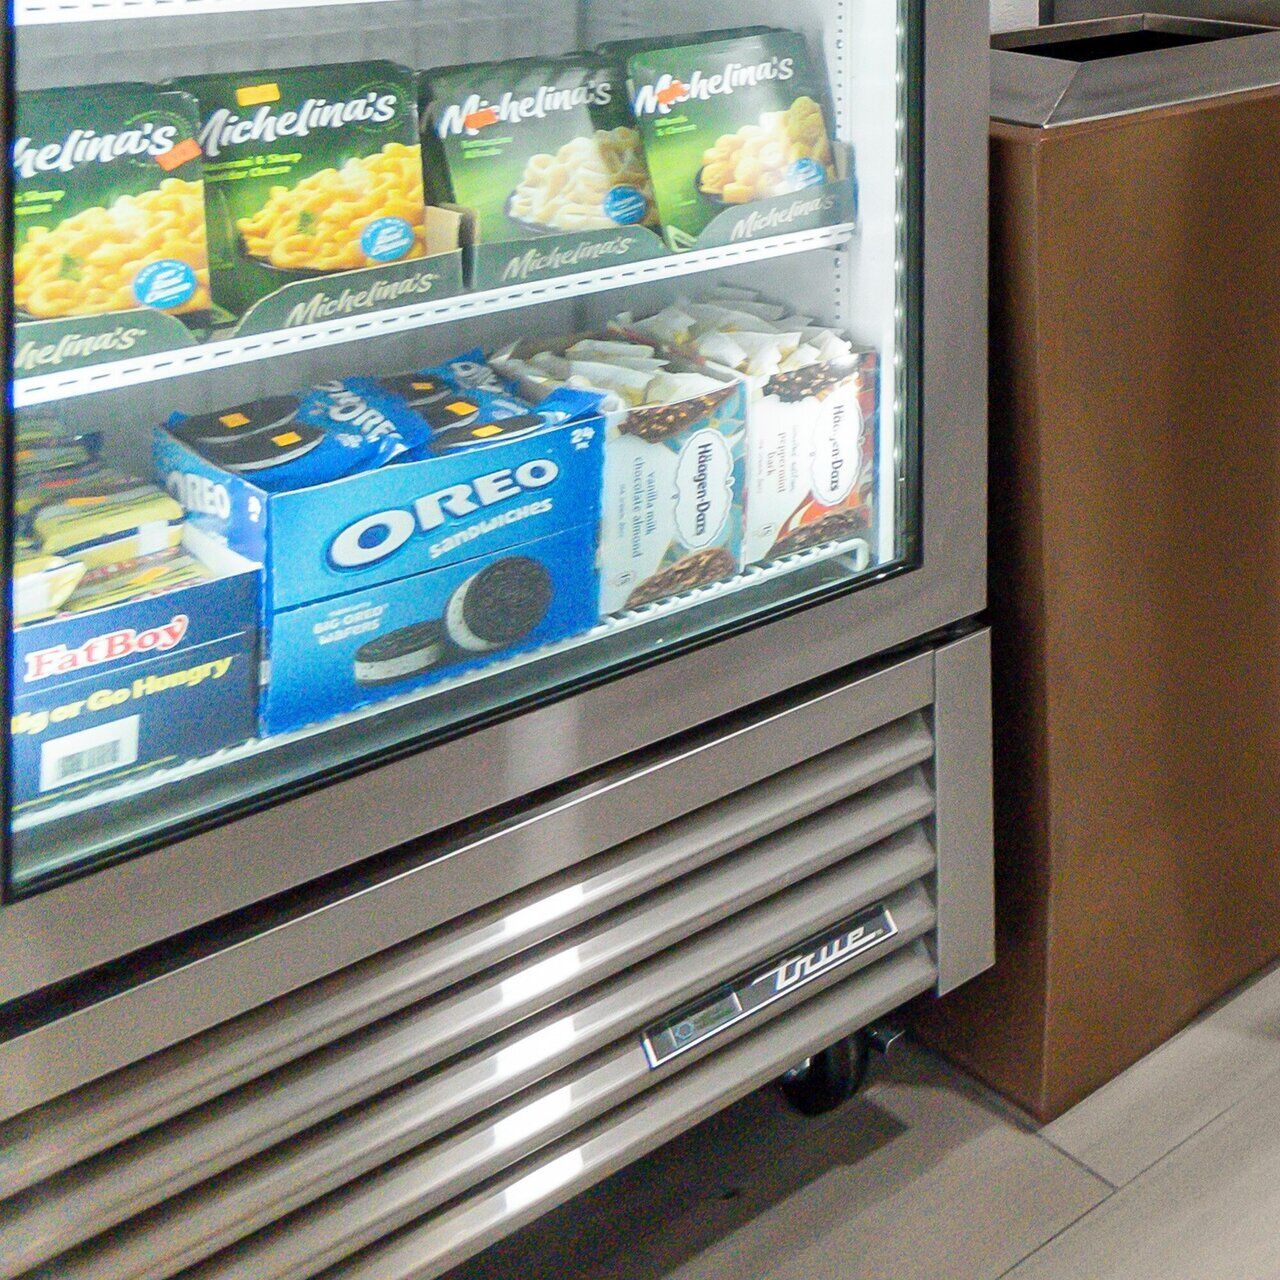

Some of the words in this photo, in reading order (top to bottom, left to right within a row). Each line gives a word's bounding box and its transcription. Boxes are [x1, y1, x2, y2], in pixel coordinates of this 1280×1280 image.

[731, 193, 835, 242] Michelina's
[503, 234, 632, 281] Michelina's
[287, 271, 434, 326] Michelina's
[632, 456, 645, 513] chocolate
[646, 471, 657, 507] vanilla
[331, 458, 558, 568] OREO
[430, 497, 553, 558] sandwiches
[632, 515, 643, 559] almond
[24, 615, 189, 682] FatBoy
[87, 688, 132, 712] Go
[132, 656, 233, 699] Hungry
